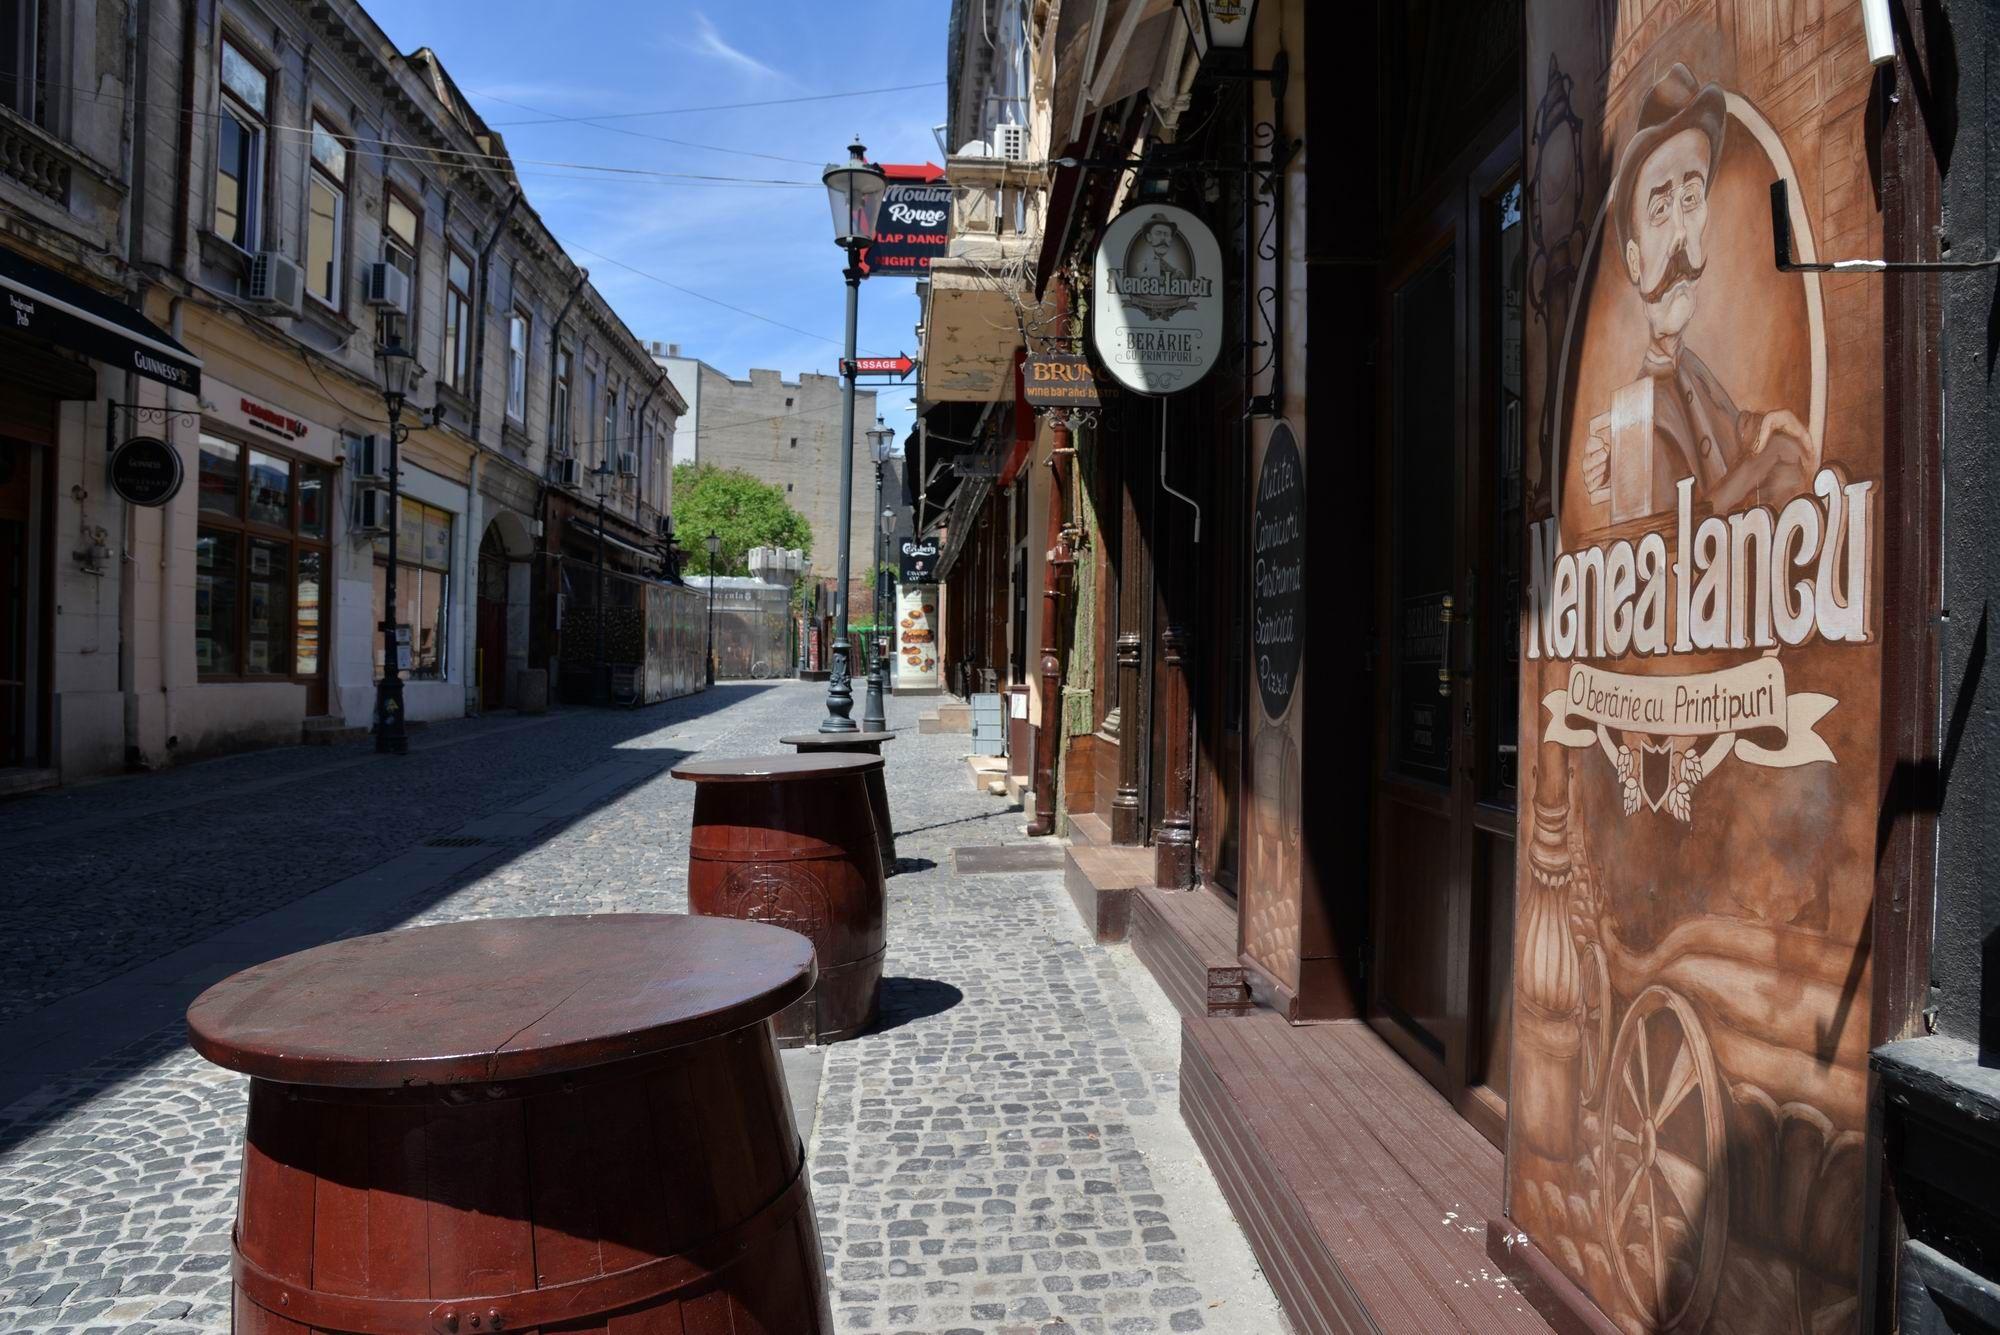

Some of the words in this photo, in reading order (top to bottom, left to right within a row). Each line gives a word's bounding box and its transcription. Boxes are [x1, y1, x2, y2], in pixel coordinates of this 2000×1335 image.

[888, 203, 947, 227] Rouge
[877, 233, 904, 244] LAP
[874, 256, 917, 267] NIGHT
[919, 257, 931, 267] C
[1107, 268, 1160, 296] Nenea
[1164, 271, 1212, 298] Iancu
[16, 309, 30, 327] Pub
[134, 350, 178, 381] GUINNESS
[857, 360, 897, 369] ASSAGE
[1125, 350, 1137, 361] CU
[1032, 362, 1112, 383] BRUNO
[1027, 387, 1049, 397] wine
[1051, 387, 1067, 397] bar
[1068, 387, 1086, 398] and
[1088, 387, 1120, 398] bistro
[1526, 516, 1670, 661] Nenea
[1672, 467, 1877, 653] Iancu
[1260, 653, 1289, 696] Pizza
[1571, 670, 1586, 706] O
[1586, 674, 1641, 722] berărie
[1643, 697, 1666, 722] cu
